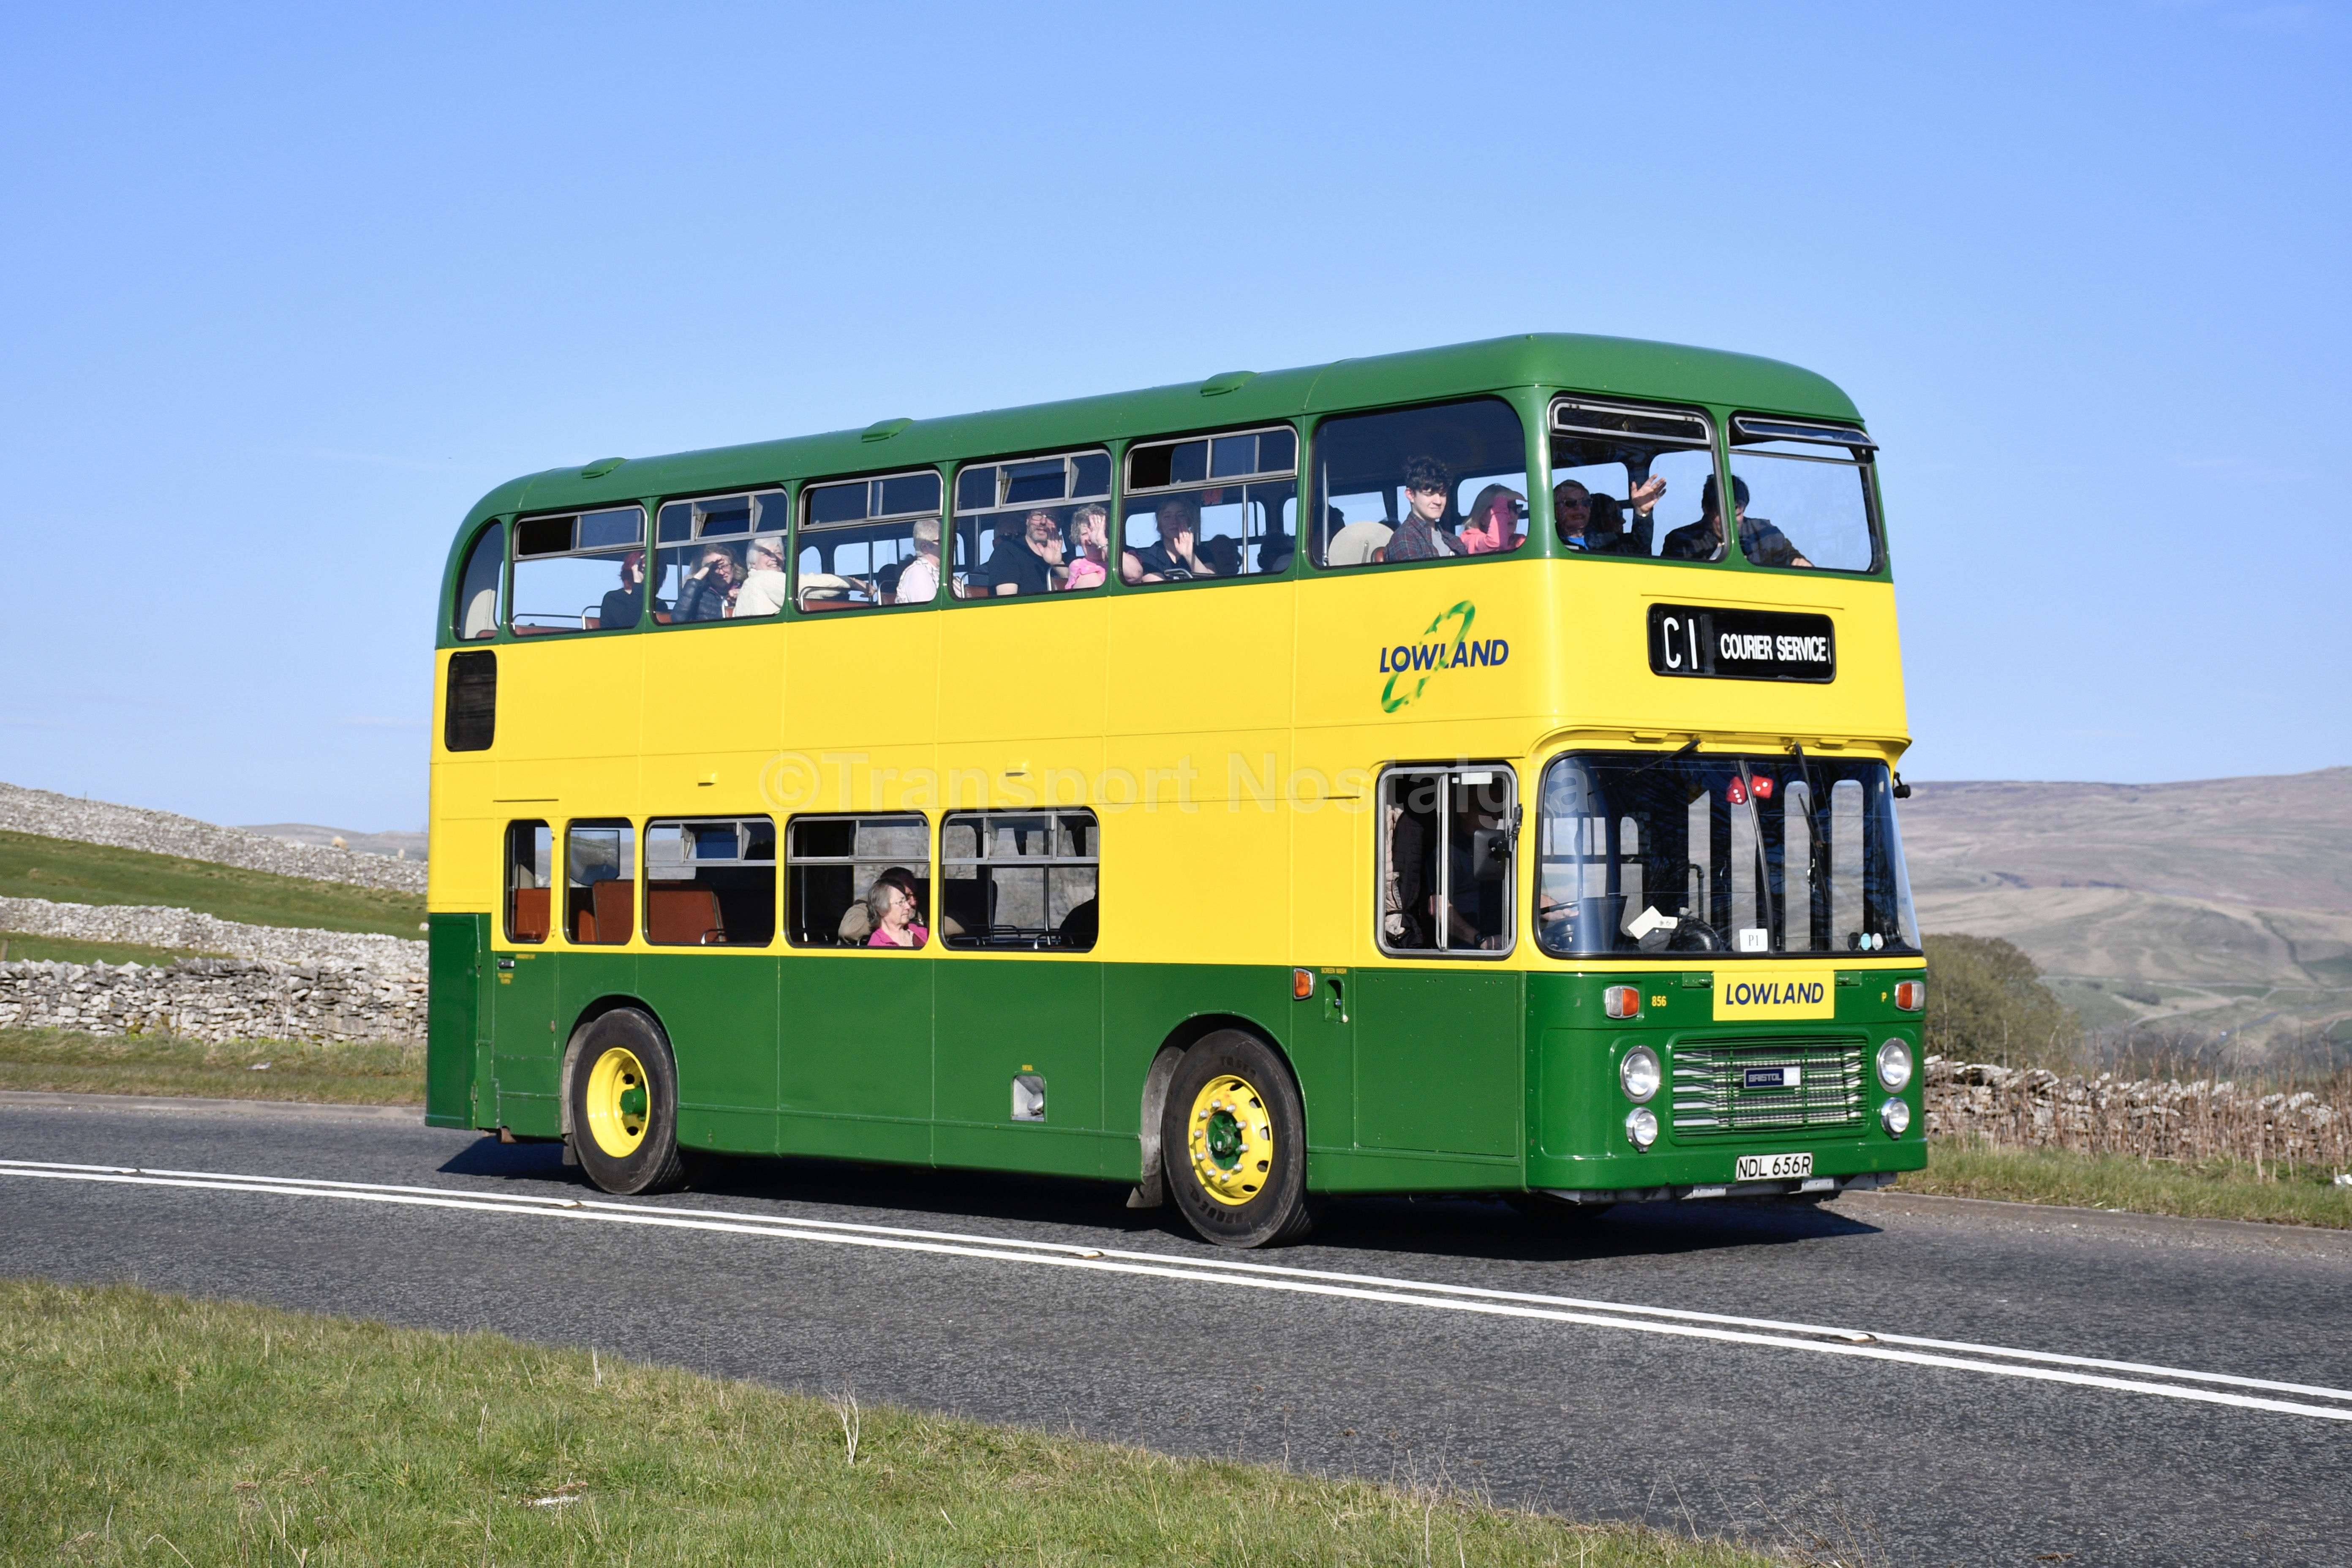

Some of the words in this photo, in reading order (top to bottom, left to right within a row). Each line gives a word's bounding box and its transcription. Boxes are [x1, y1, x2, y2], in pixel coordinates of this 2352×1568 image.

[1380, 639, 1508, 673] LOWLAND
[1720, 633, 1773, 660] COURIER
[1776, 635, 1827, 662] SERVICE
[1748, 934, 1759, 946] P1
[1651, 995, 1667, 1007] 856
[1726, 983, 1824, 1005] LOWLAND
[1881, 992, 1887, 1002] P
[1748, 1073, 1782, 1083] BRISTOL
[1738, 1158, 1767, 1178] NDL
[1772, 1156, 1811, 1176] 656R
